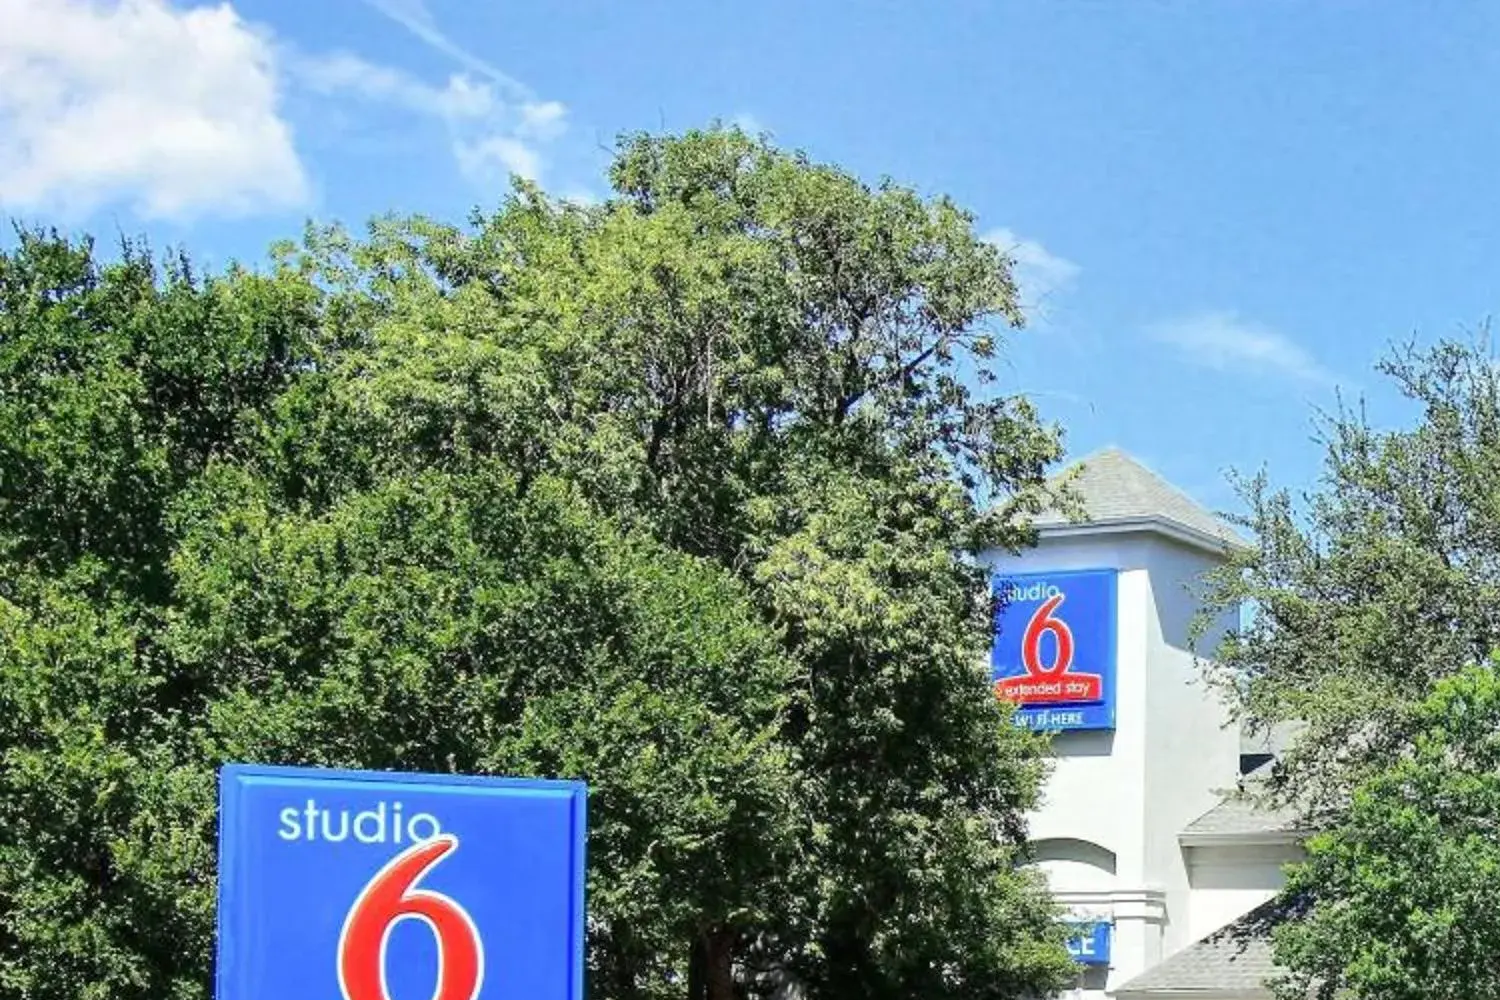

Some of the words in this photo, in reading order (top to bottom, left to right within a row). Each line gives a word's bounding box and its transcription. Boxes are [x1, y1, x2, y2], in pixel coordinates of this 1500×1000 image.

[1022, 593, 1074, 676] 6
[1004, 681, 1062, 697] extended
[1065, 681, 1090, 698] stay
[1050, 711, 1084, 726] HERE
[278, 799, 442, 844] studio
